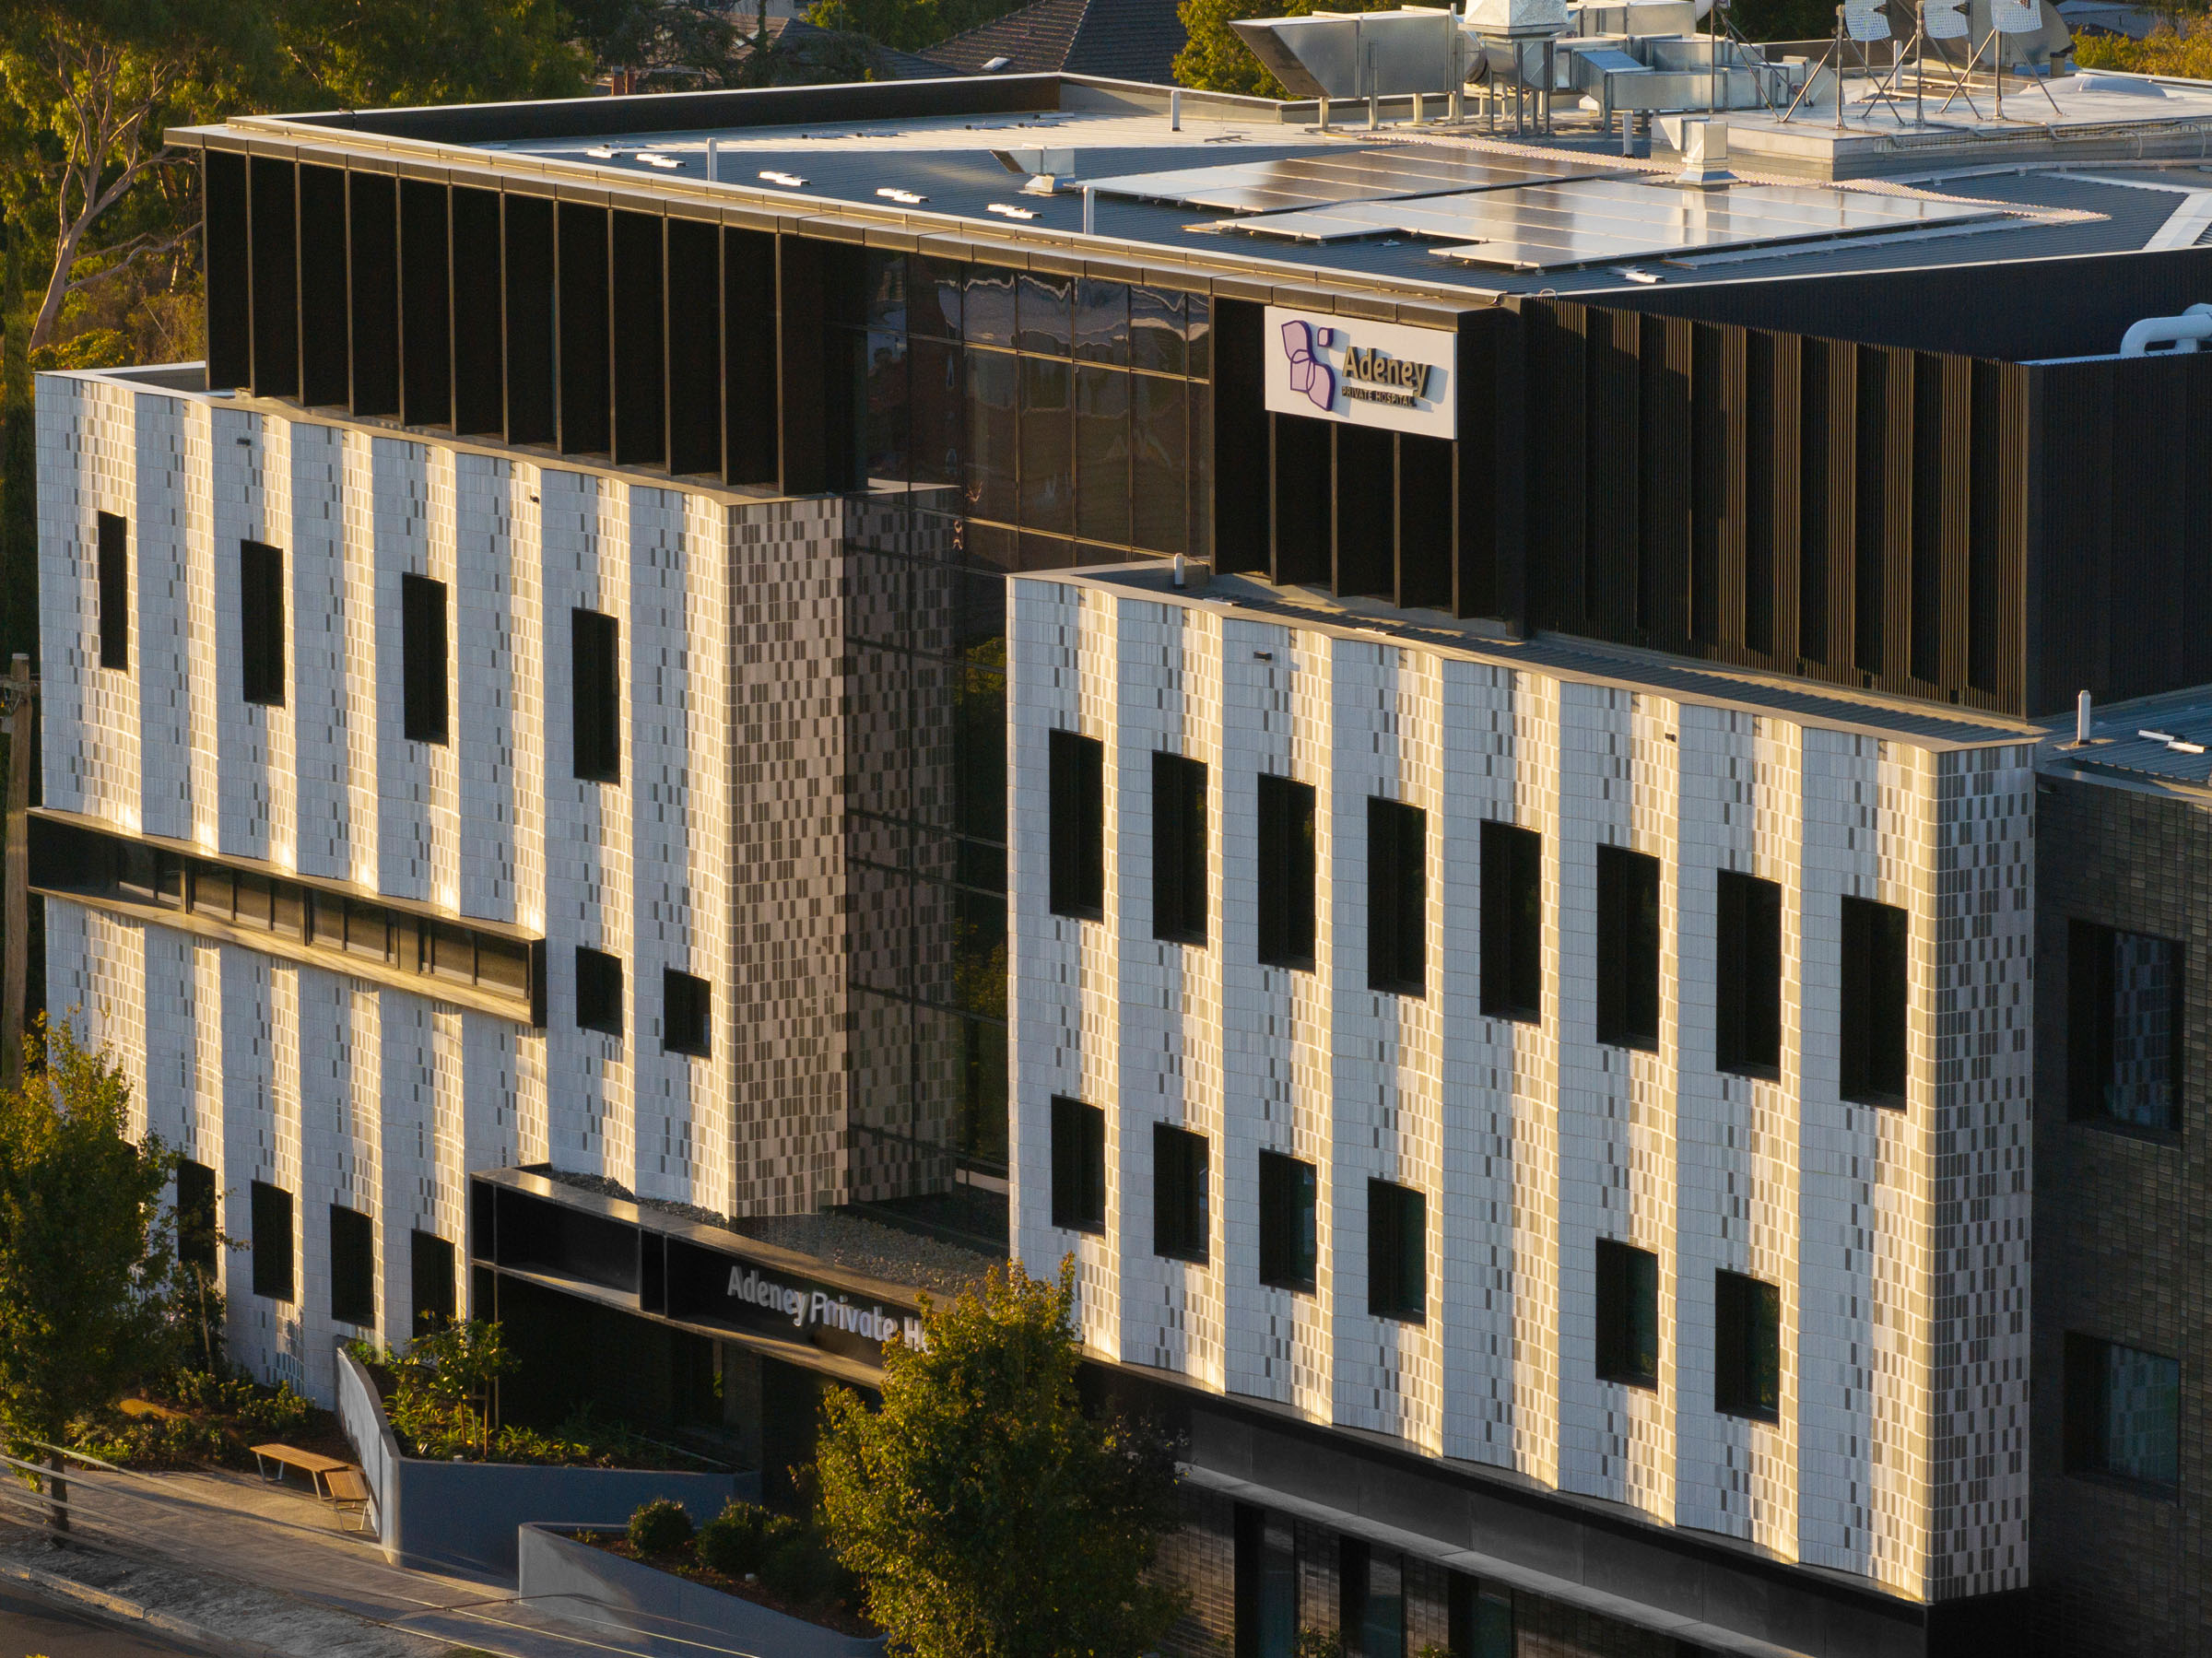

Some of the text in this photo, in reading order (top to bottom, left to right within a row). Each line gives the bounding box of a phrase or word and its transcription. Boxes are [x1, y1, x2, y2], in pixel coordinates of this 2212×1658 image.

[1341, 386, 1416, 406] PRIVATE HOSPITAL
[1342, 347, 1430, 398] Adeney
[727, 1265, 808, 1327] Adeney
[809, 1291, 898, 1342] Private
